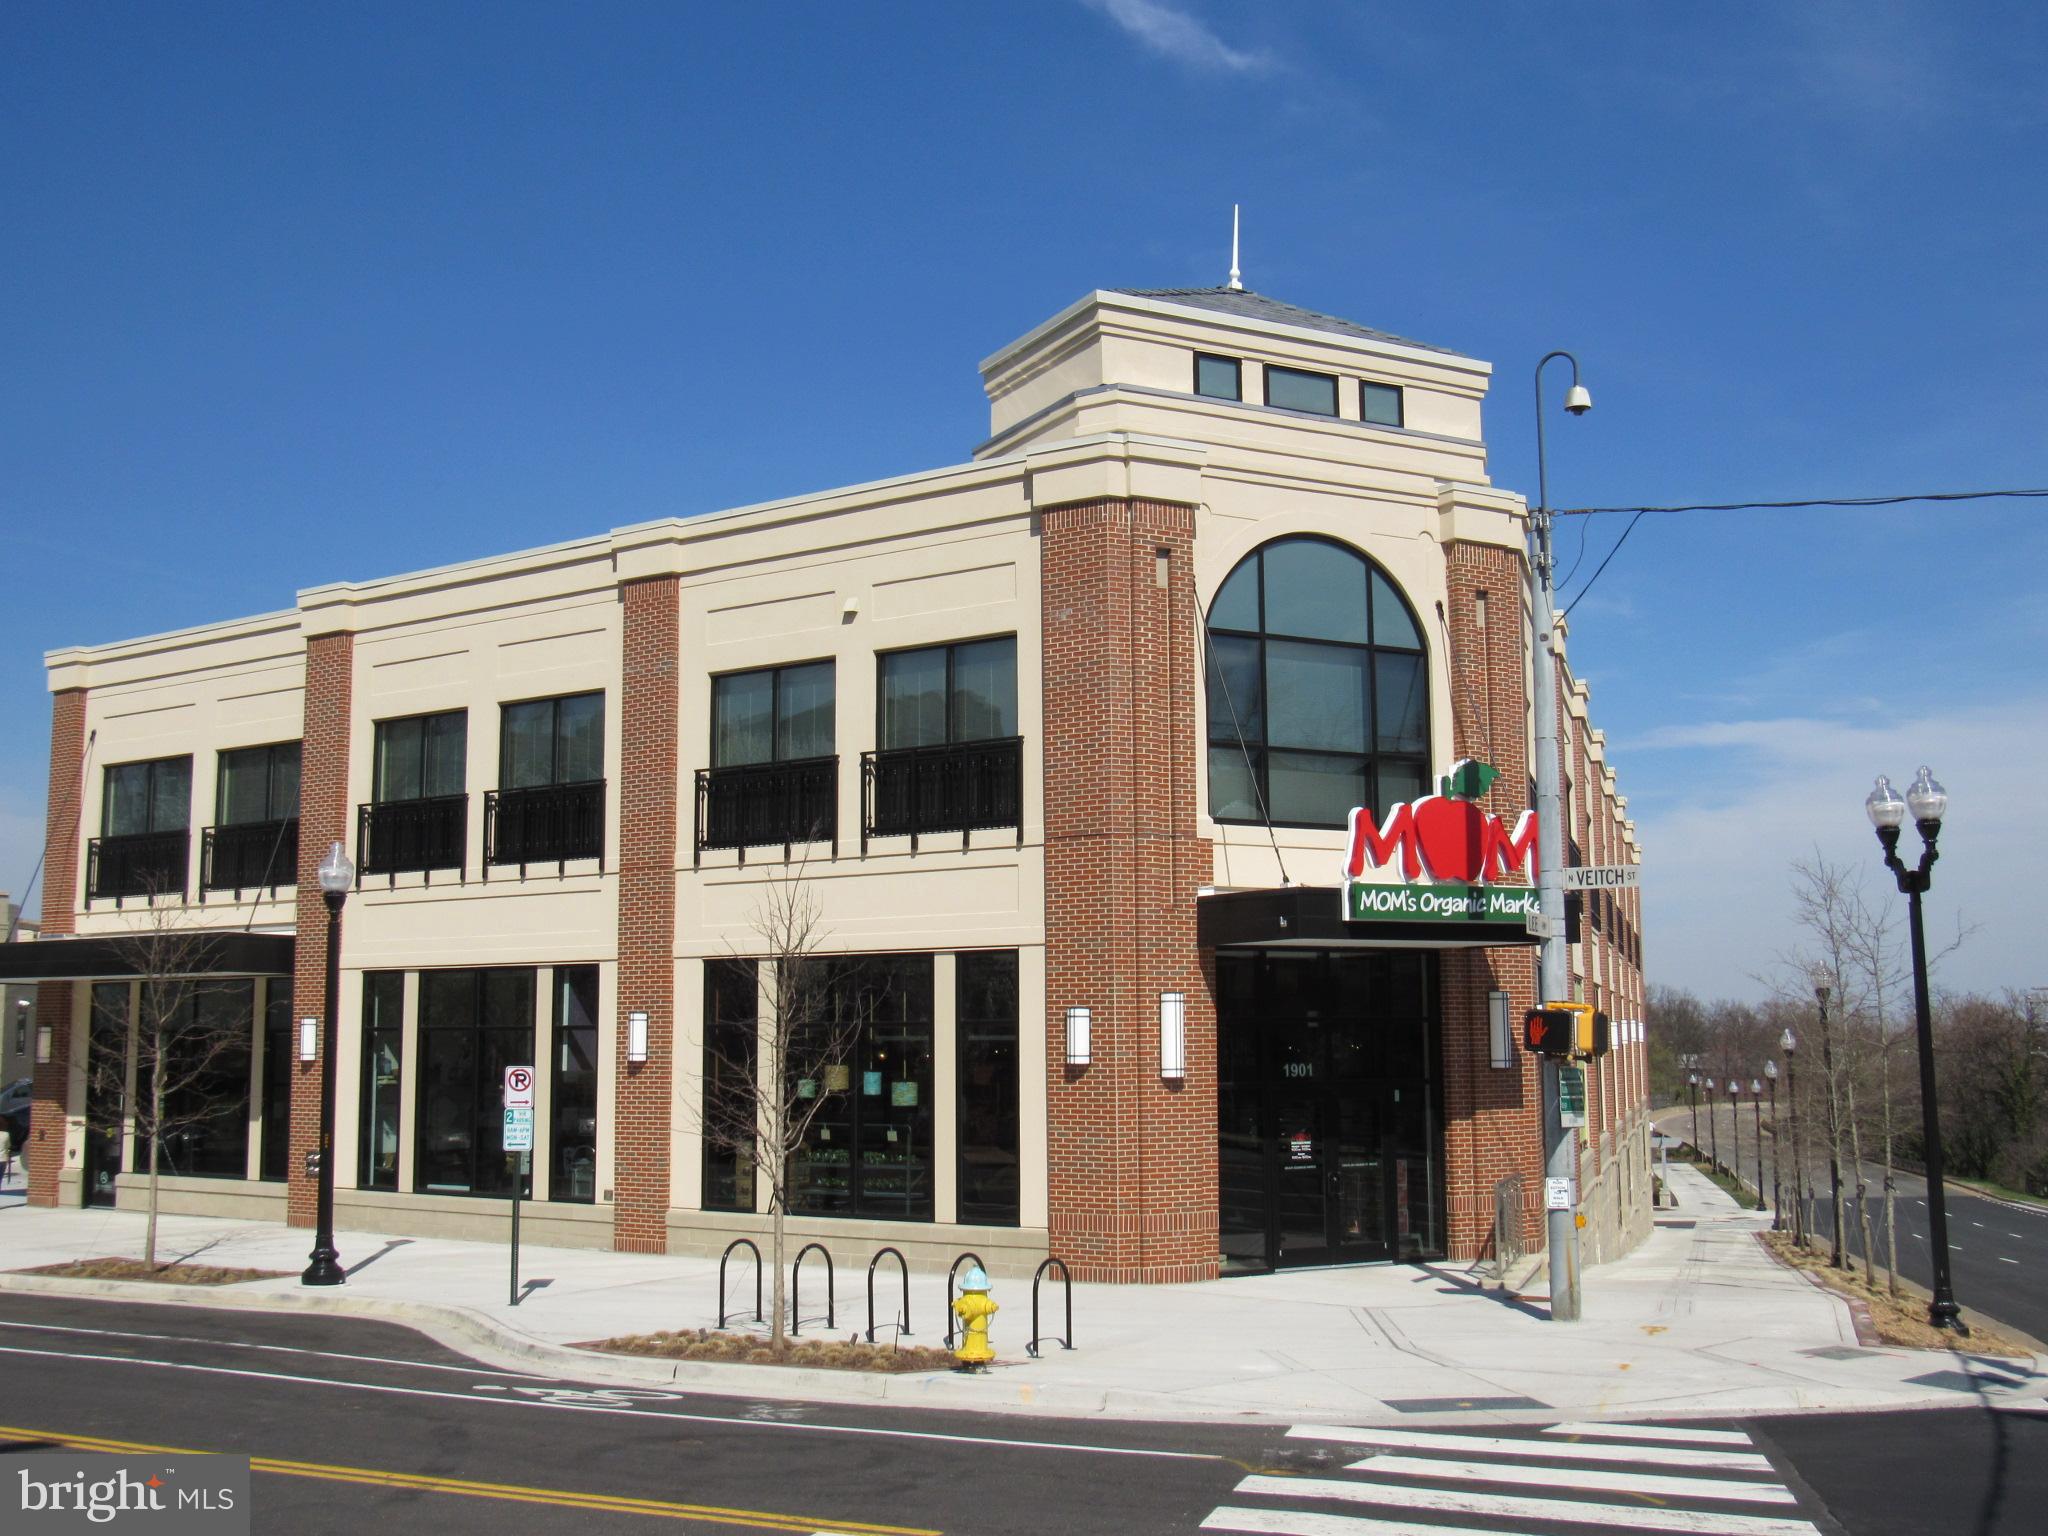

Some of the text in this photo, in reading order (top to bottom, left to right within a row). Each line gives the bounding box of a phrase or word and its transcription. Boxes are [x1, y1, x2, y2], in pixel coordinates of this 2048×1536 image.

[1568, 868, 1636, 886] N VEITCH ST
[1360, 889, 1541, 917] MOM's Organic Marke
[1528, 914, 1538, 932] LEE
[1283, 1063, 1313, 1078] 1901
[506, 1111, 513, 1123] 2
